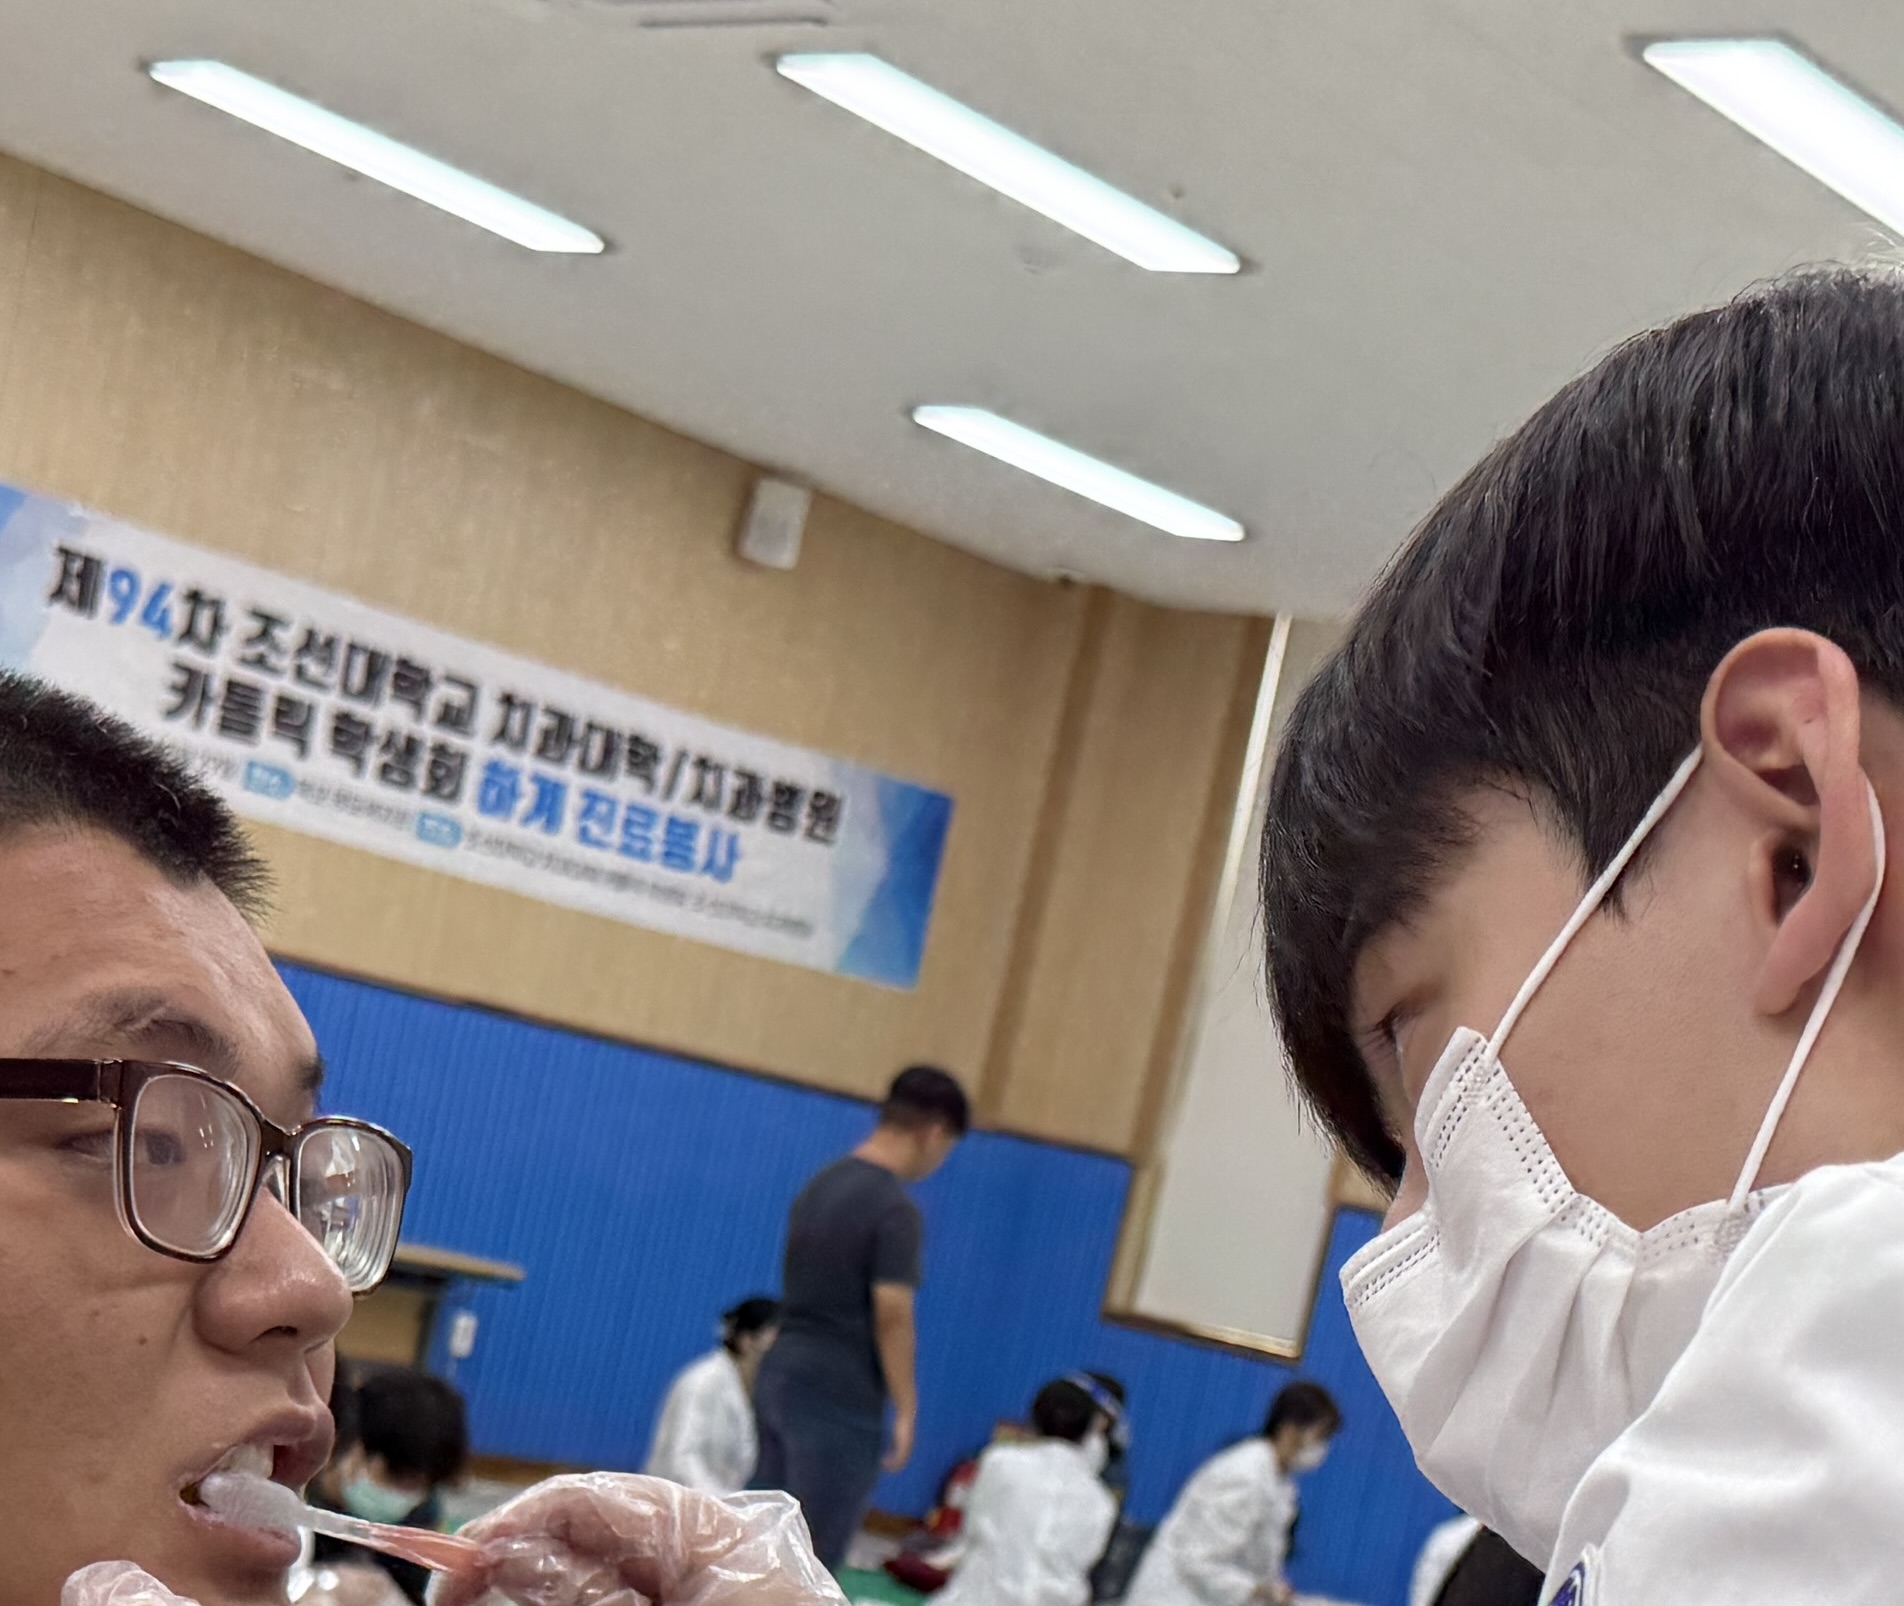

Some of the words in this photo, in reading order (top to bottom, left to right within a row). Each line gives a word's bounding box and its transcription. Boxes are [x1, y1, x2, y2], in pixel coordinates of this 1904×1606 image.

[50, 547, 225, 653] 제94차
[240, 607, 482, 738] 조선대학교
[492, 693, 844, 844] 치과대학/치과병원
[330, 709, 469, 801] 학생회
[476, 758, 570, 835] 하계
[576, 786, 742, 884] 진료봉사
